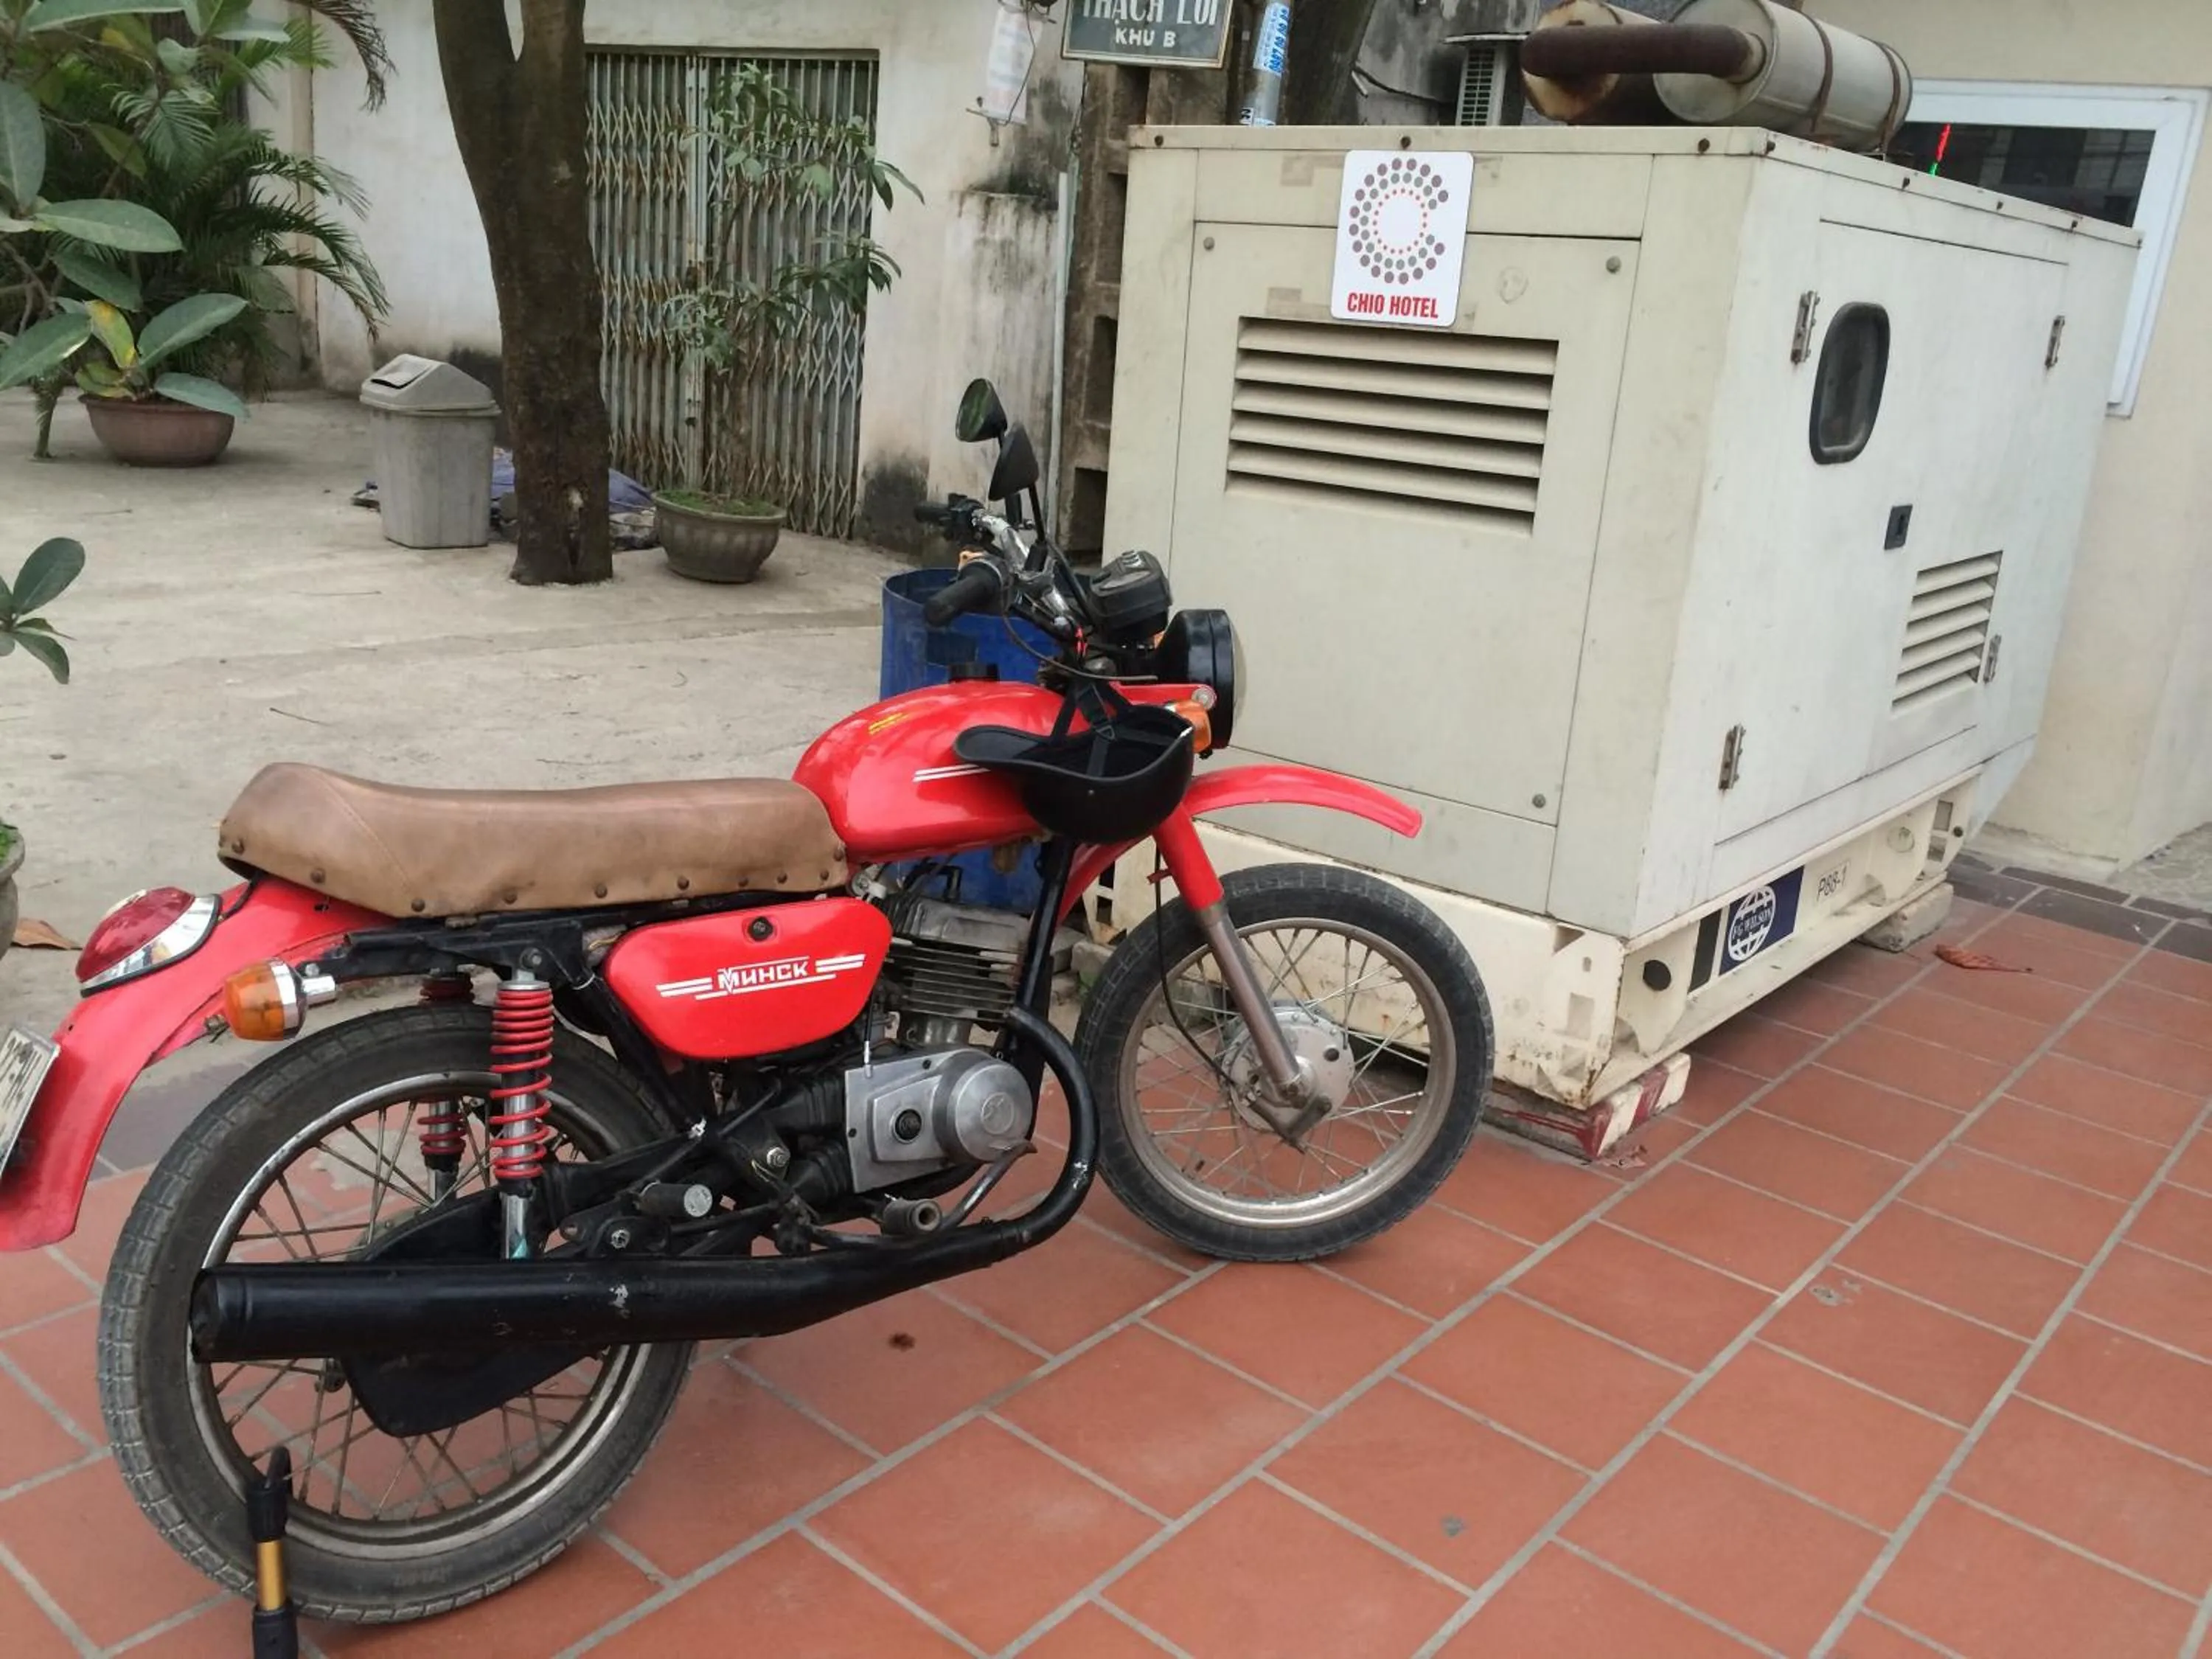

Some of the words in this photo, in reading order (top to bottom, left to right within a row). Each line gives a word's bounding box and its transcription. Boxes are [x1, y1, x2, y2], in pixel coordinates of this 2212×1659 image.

[1116, 27, 1155, 46] KHU
[1163, 30, 1177, 48] B
[1347, 292, 1385, 314] CHIO
[1389, 296, 1439, 319] HOTEL
[1744, 909, 1772, 932] WILSON
[717, 960, 809, 994] МИНСК
